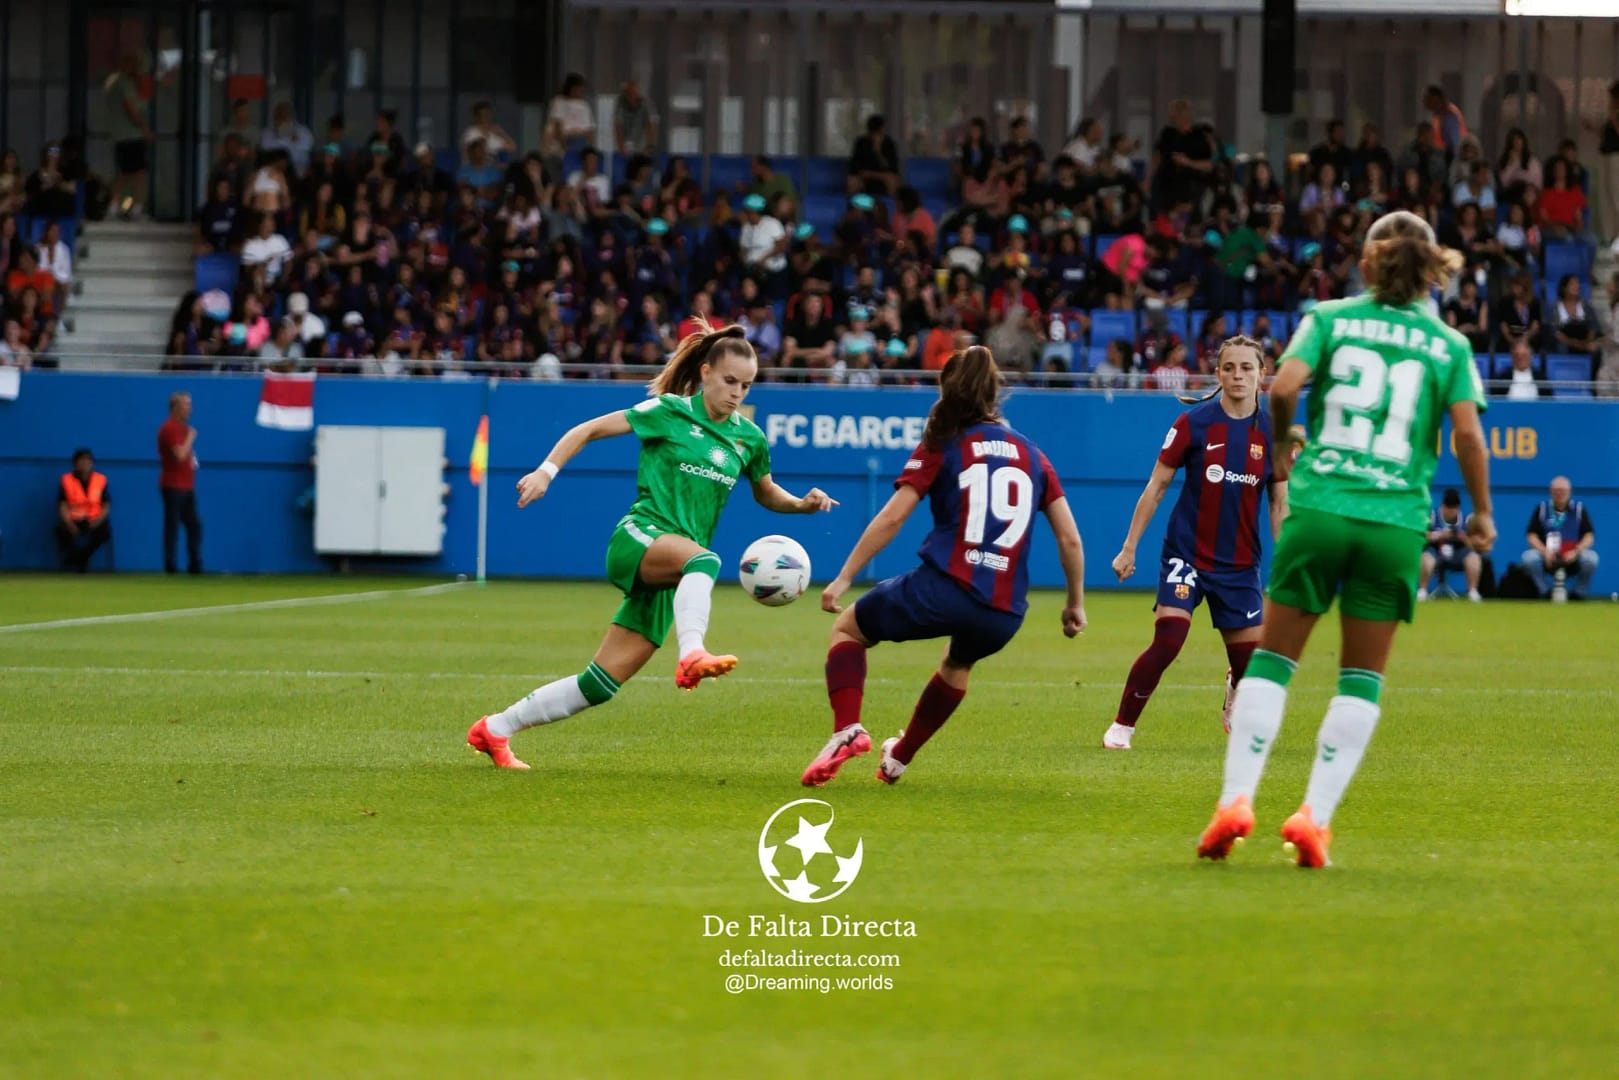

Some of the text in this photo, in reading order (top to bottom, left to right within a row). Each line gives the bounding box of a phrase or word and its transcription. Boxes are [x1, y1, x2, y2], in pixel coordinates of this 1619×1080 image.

[1318, 344, 1425, 465] 21
[766, 414, 930, 450] FC BARCE
[1450, 427, 1537, 458] UB
[1225, 470, 1260, 487] Spotify
[958, 463, 1034, 549] 19
[1166, 557, 1198, 588] 22
